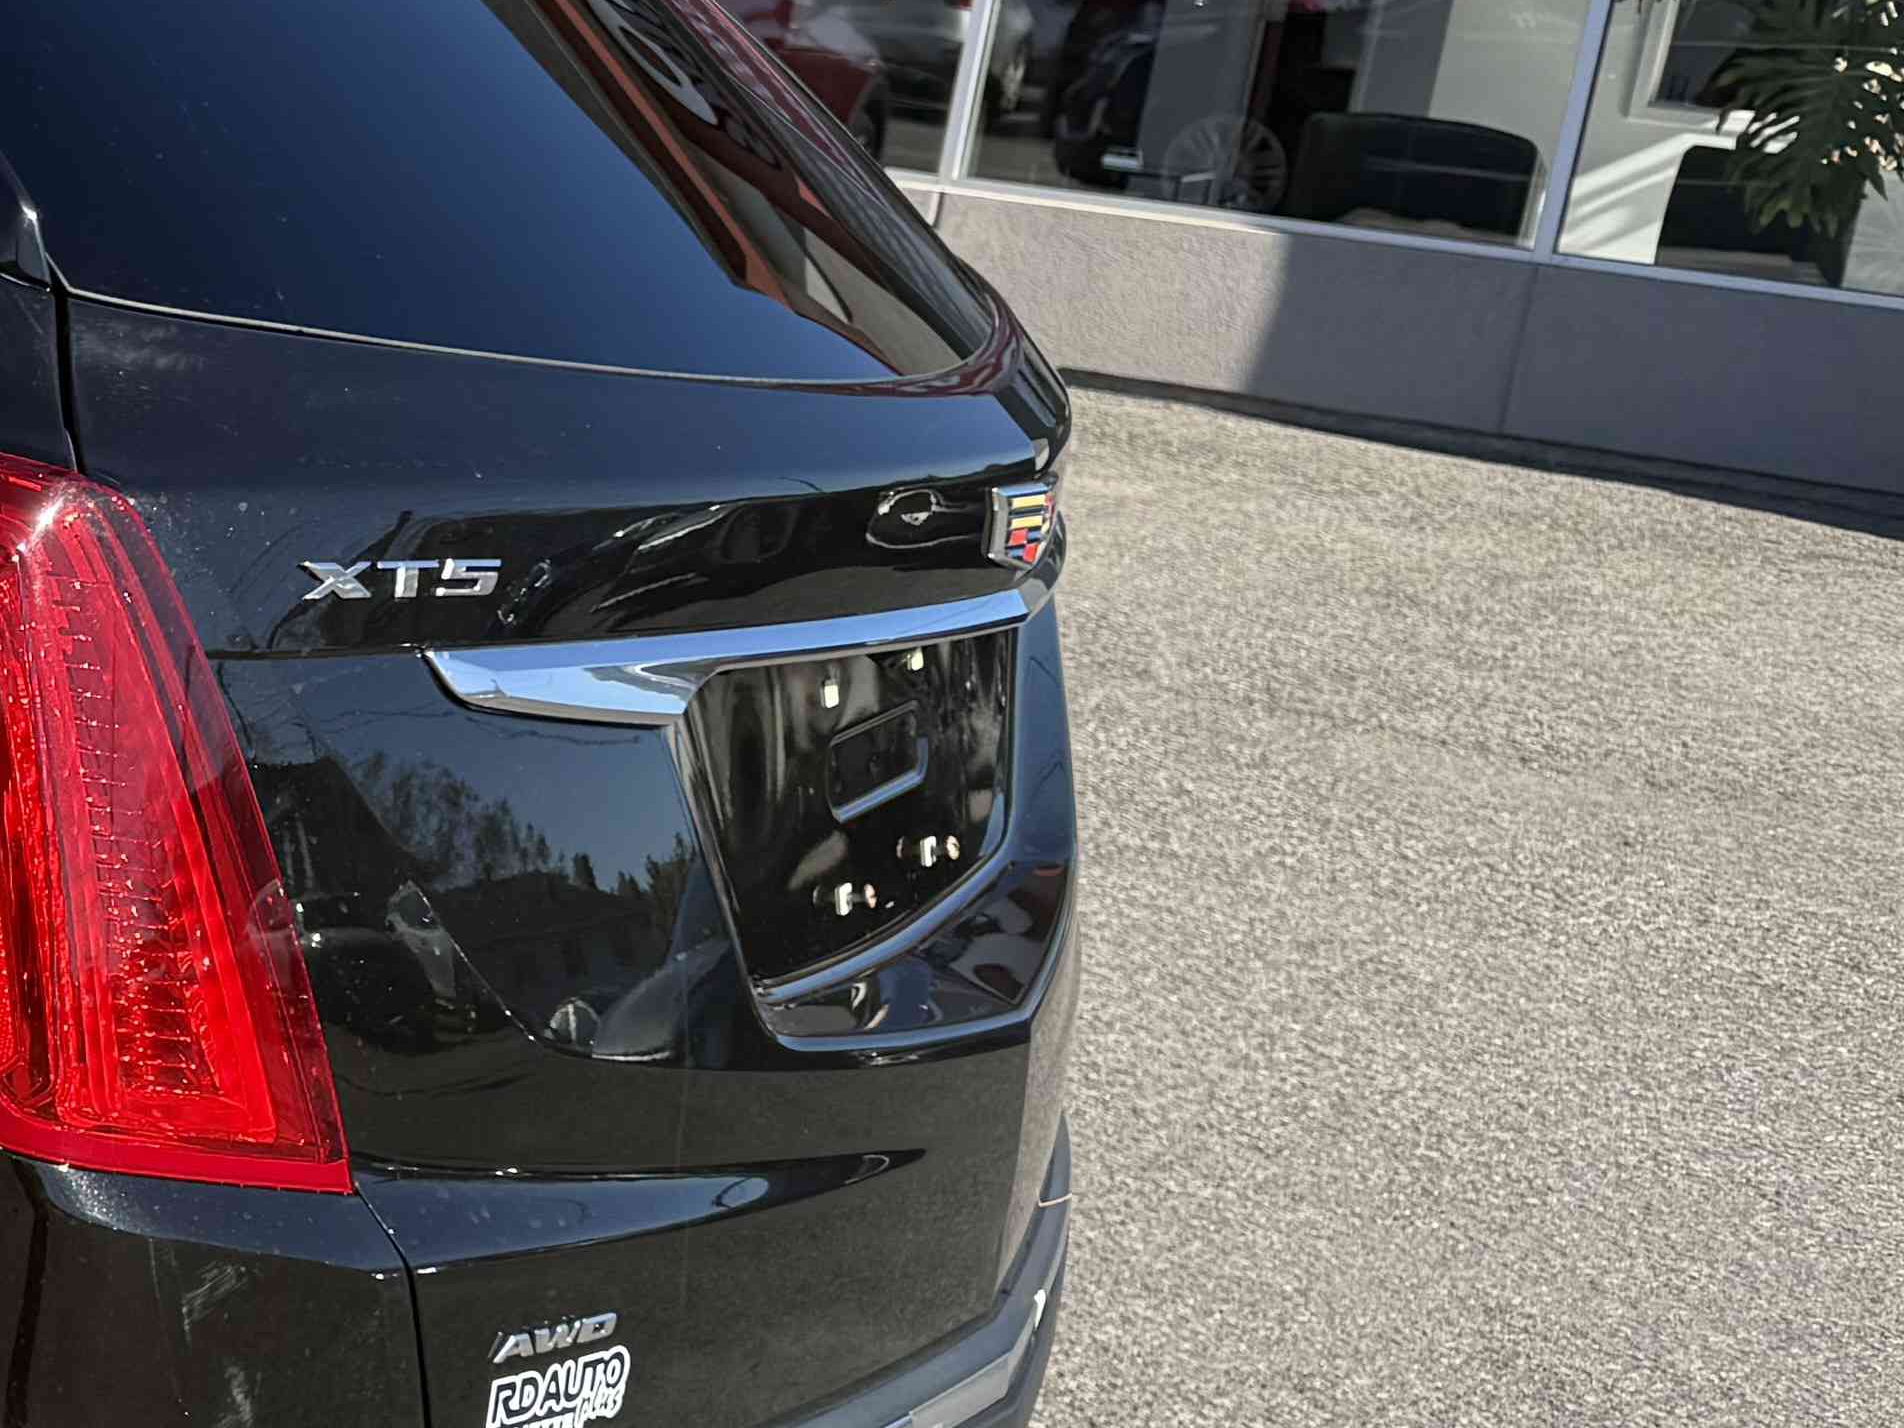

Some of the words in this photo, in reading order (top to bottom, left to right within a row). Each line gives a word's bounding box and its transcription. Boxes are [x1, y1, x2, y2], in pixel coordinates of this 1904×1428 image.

[298, 557, 503, 601] XT5
[490, 1312, 617, 1364] AWD
[487, 1346, 630, 1428] RDAUTO
